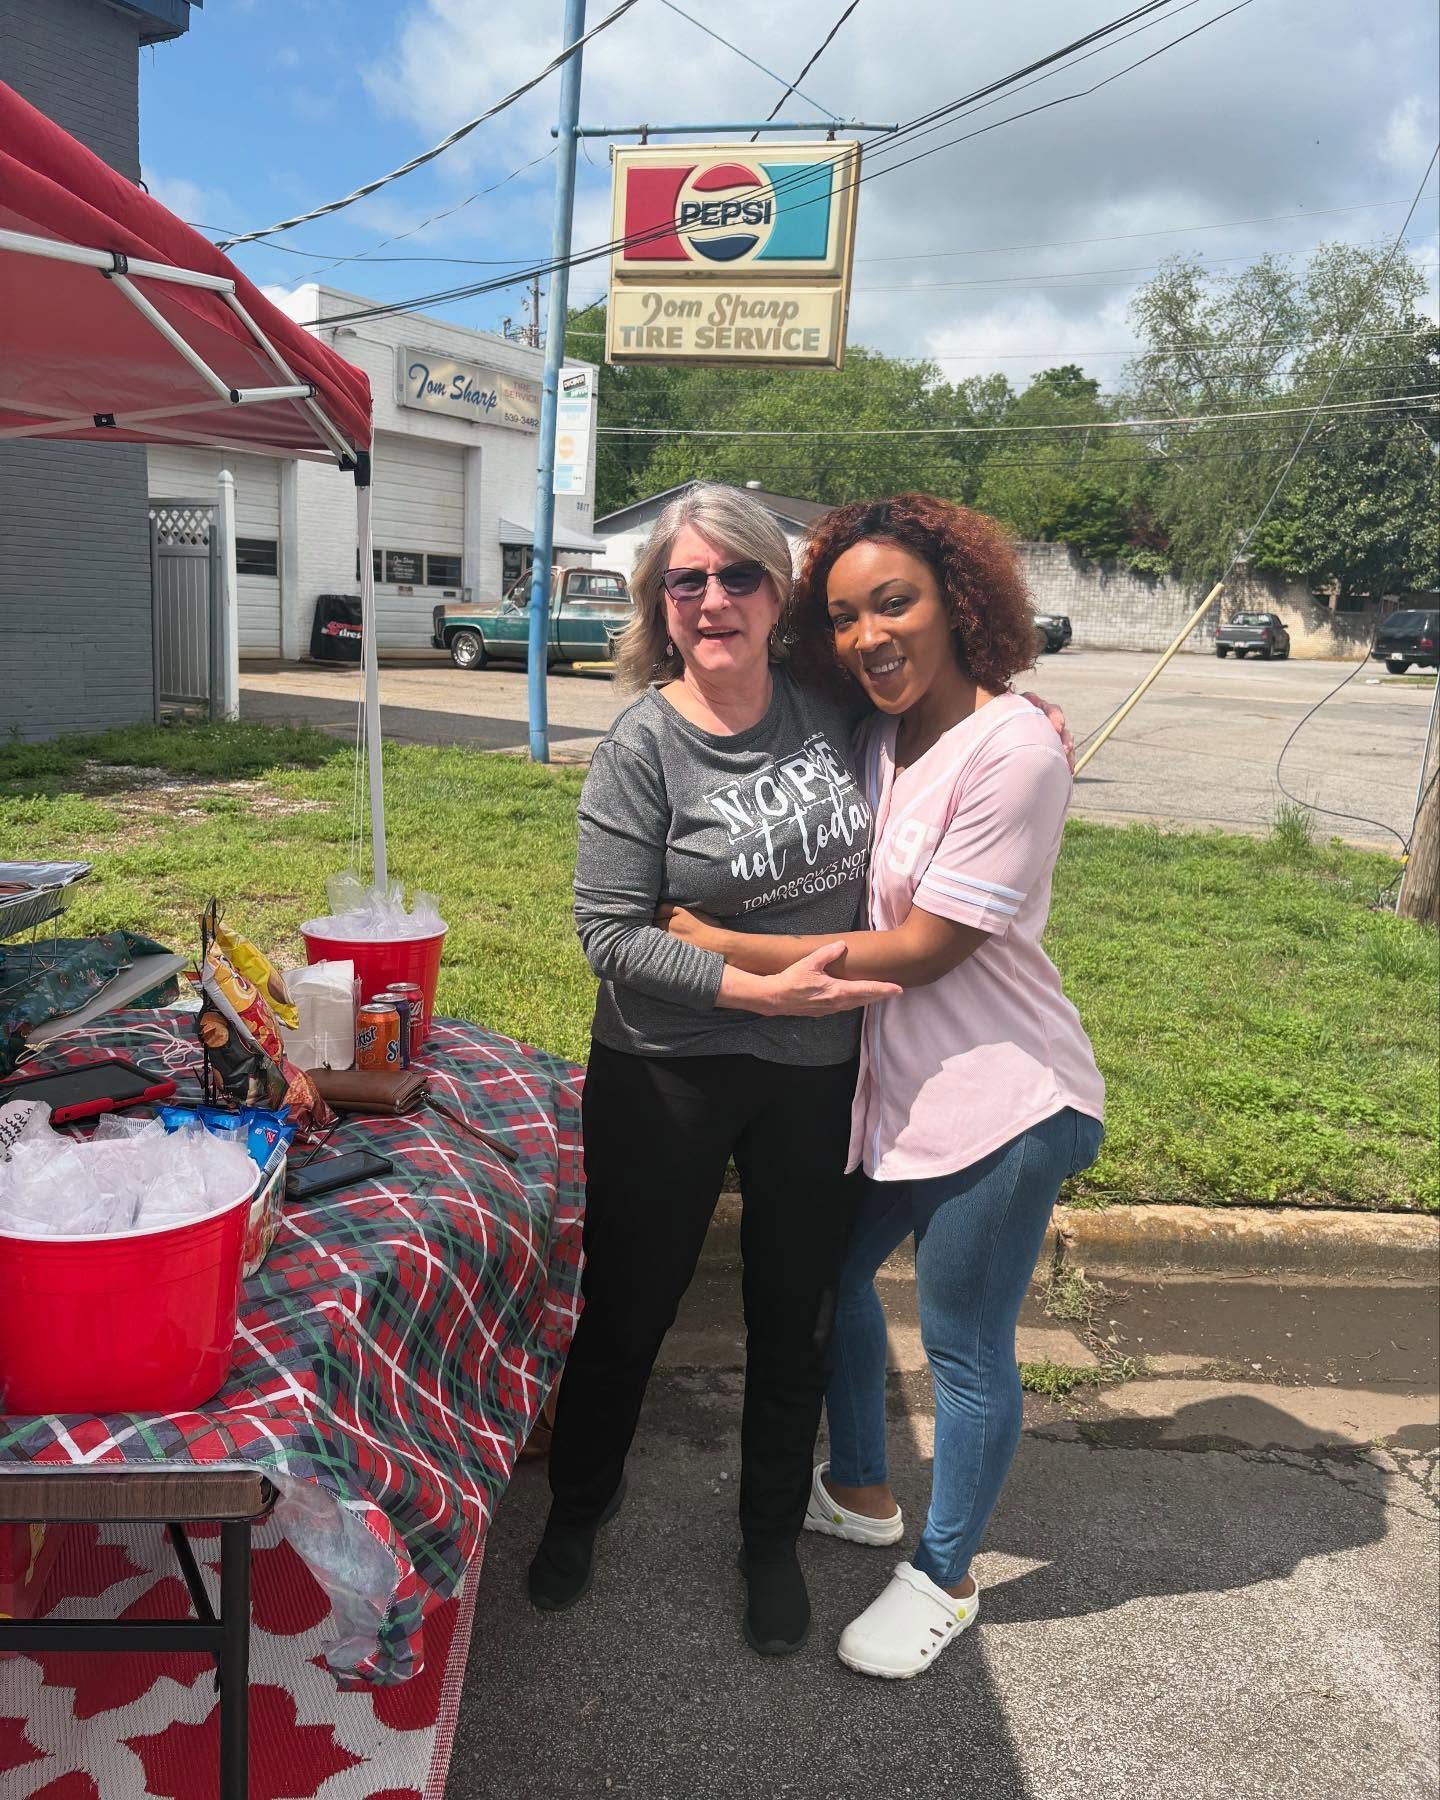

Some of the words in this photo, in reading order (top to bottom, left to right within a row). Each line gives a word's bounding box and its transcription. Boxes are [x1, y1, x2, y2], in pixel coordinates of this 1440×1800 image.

[681, 200, 772, 225] PEPSI
[641, 292, 702, 325] Tom
[707, 293, 800, 327] Sharp
[619, 325, 683, 348] TIRE
[694, 326, 820, 351] SERVICE
[408, 363, 447, 399] Tom
[450, 375, 498, 414] Sharp
[711, 741, 851, 834] NOPE
[731, 818, 787, 880] not
[841, 848, 866, 871] NOT
[888, 818, 932, 876] 9
[802, 872, 847, 894] GOOD
